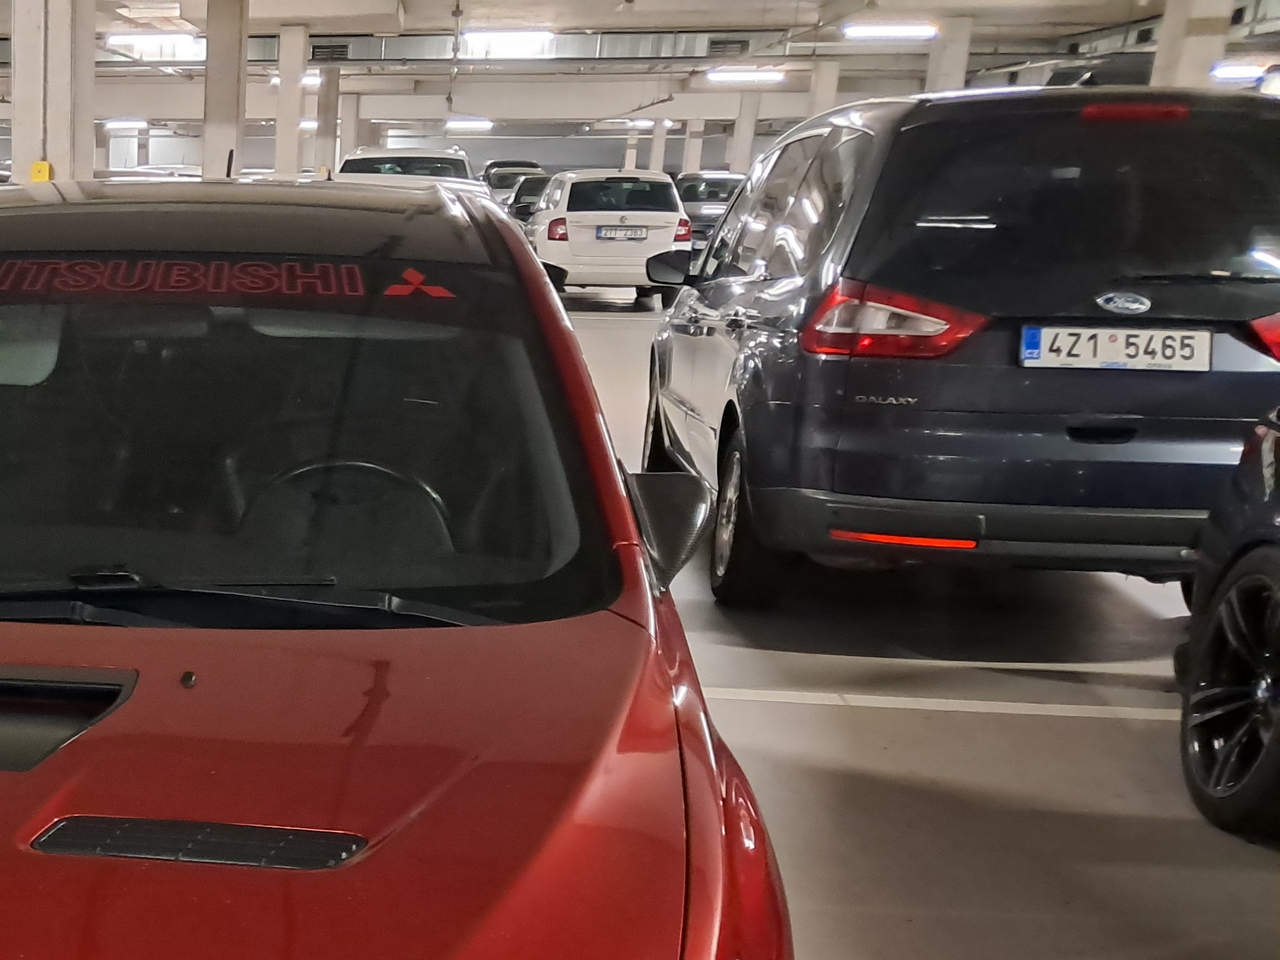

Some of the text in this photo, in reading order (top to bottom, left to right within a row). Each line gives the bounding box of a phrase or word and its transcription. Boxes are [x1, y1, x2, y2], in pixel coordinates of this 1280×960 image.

[1025, 349, 1039, 358] CZ
[1048, 332, 1196, 361] 4Z1 5465
